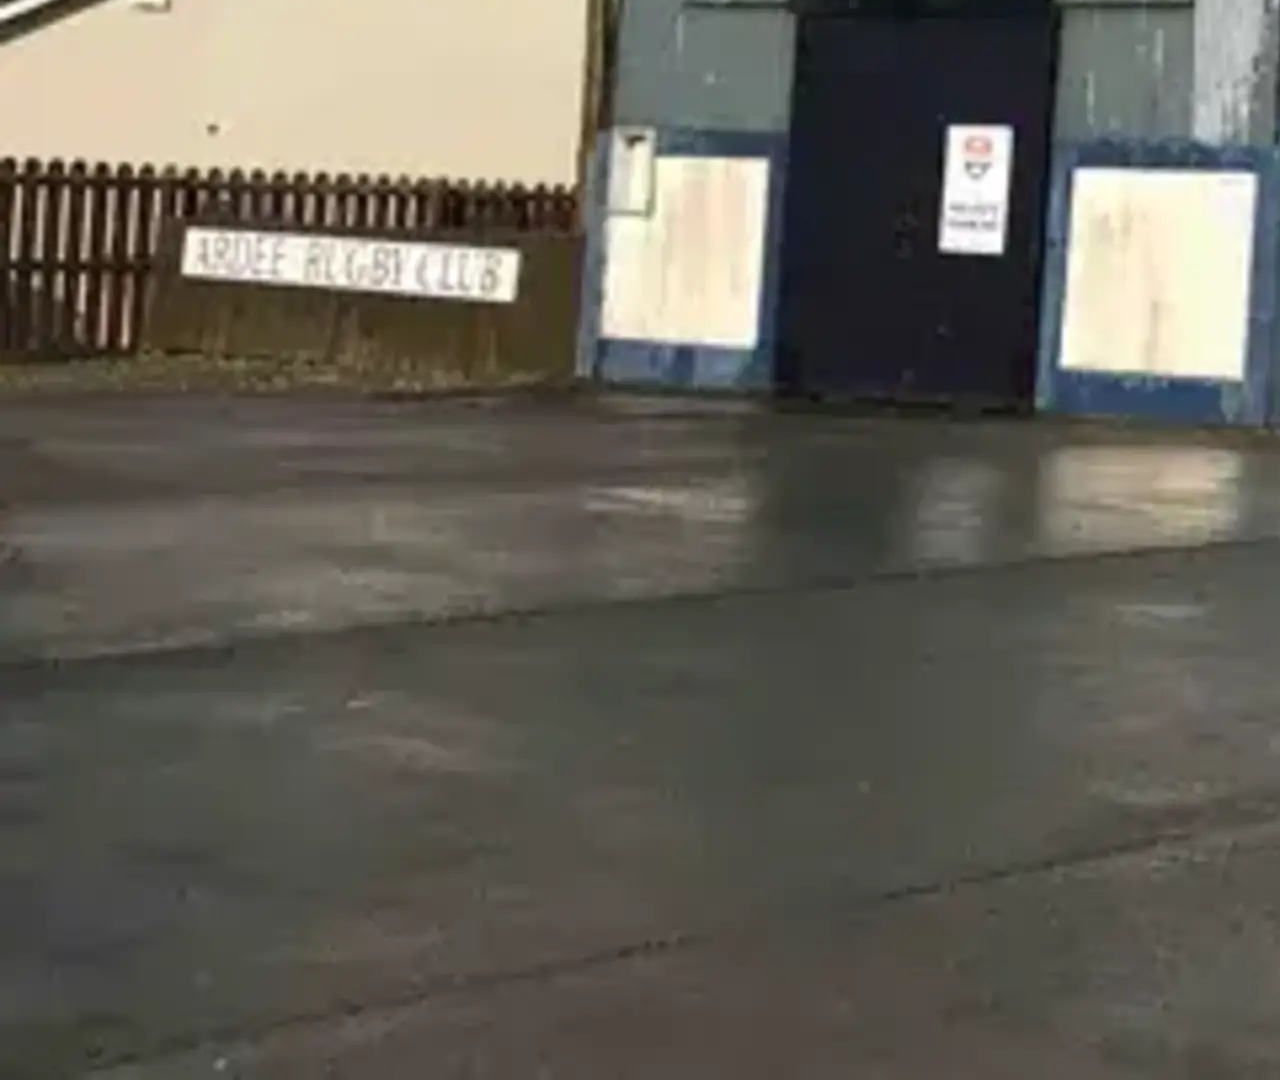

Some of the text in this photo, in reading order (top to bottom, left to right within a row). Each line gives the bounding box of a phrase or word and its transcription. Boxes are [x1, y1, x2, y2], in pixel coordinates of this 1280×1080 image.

[197, 235, 504, 293] ARDEE RUGBY CLUB
